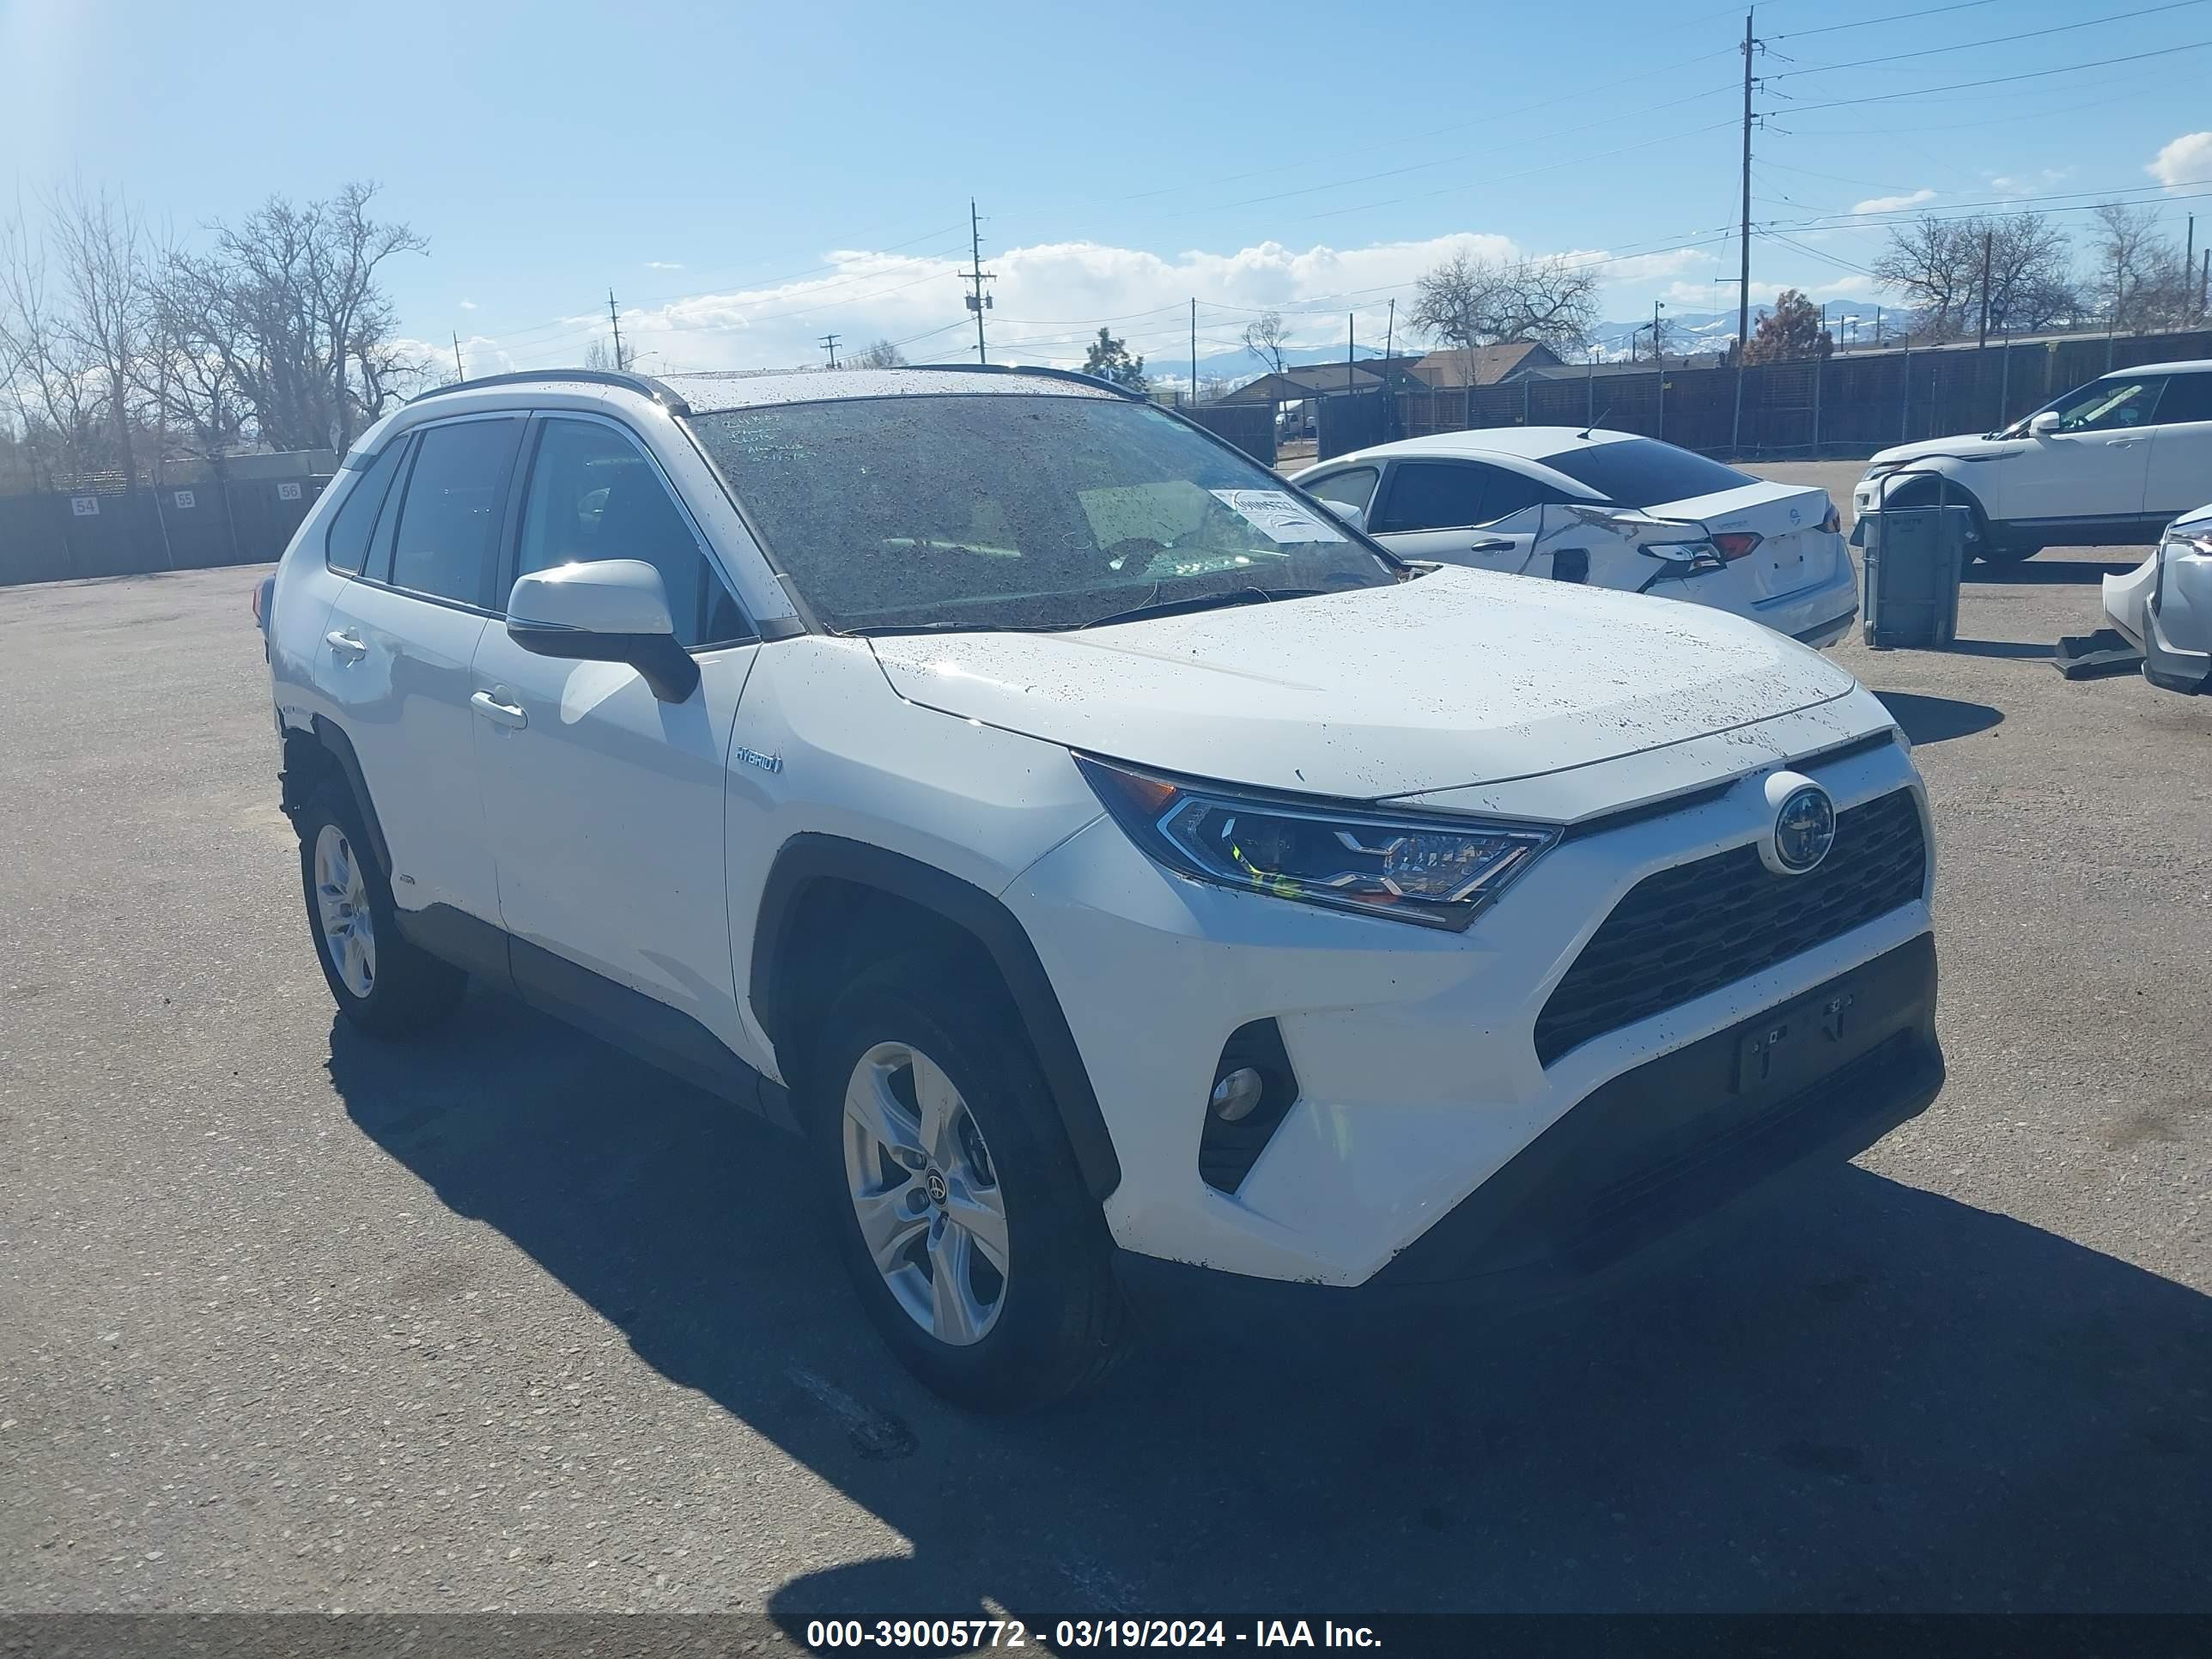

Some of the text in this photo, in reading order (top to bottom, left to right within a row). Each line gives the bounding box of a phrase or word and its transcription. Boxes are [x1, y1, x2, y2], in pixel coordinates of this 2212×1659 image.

[282, 485, 299, 498] 56
[76, 500, 97, 514] 54
[178, 493, 193, 507] 55
[735, 745, 774, 770] HYBRID
